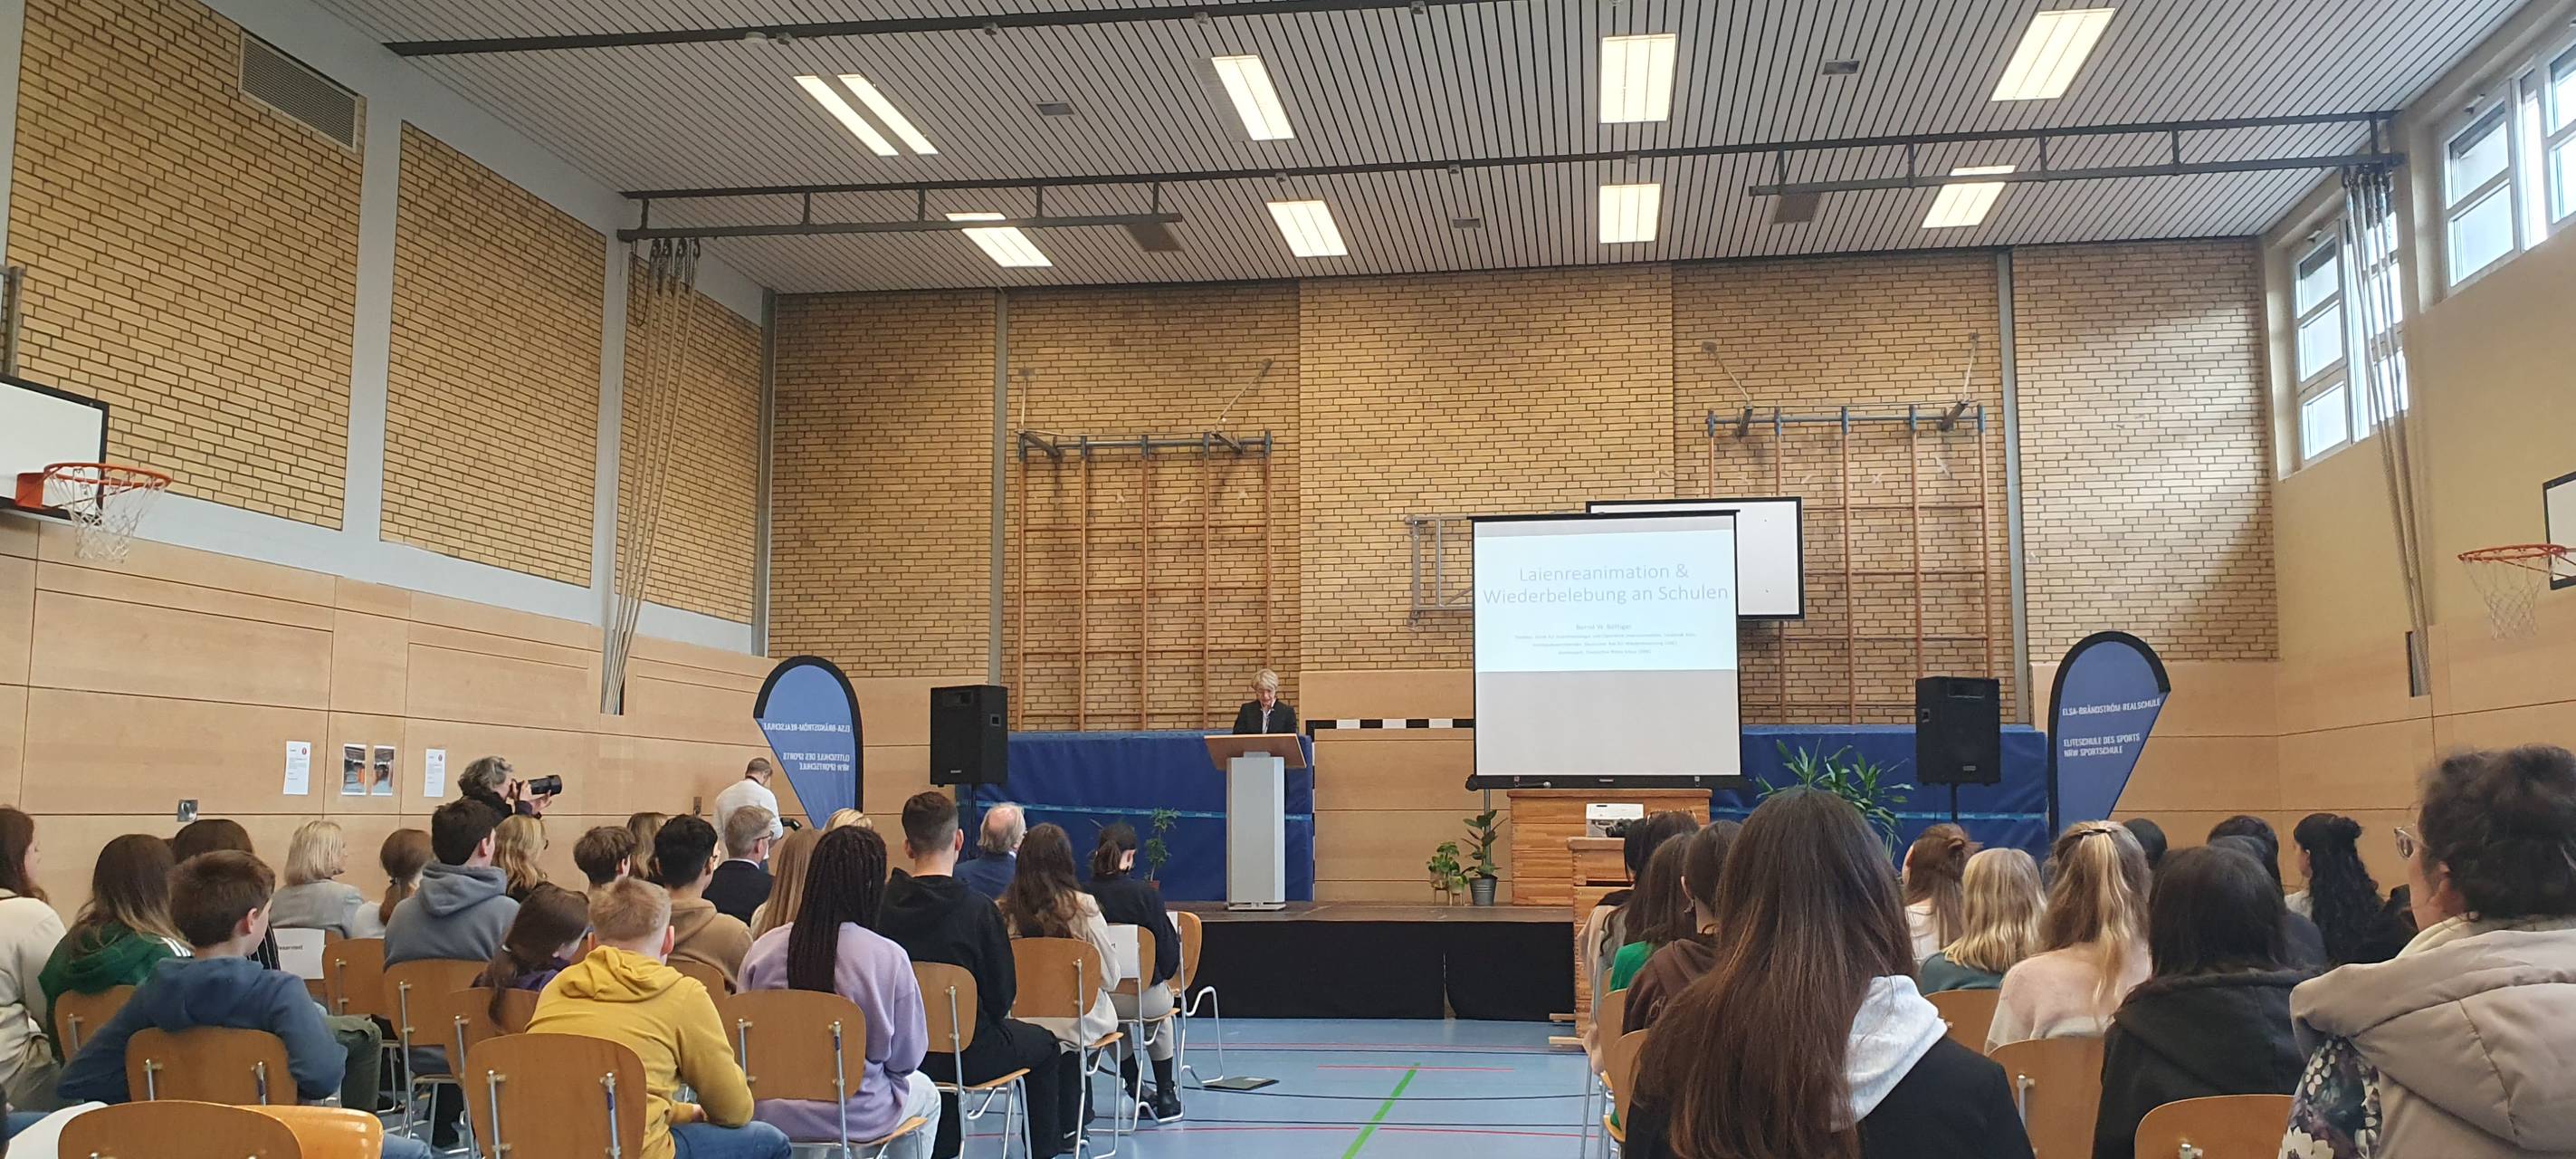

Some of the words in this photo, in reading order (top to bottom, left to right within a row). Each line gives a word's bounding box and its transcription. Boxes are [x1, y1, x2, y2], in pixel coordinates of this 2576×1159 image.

[1520, 565, 1669, 581] Laienreanimation
[1675, 563, 1689, 579] &
[1484, 587, 1627, 605] Wiederbelebung
[1632, 589, 1652, 601] an
[1658, 584, 1728, 600] Schulen
[2103, 735, 2115, 744] DES
[2116, 733, 2141, 743] SPORTS
[2080, 746, 2123, 757] SPORTSCHULE
